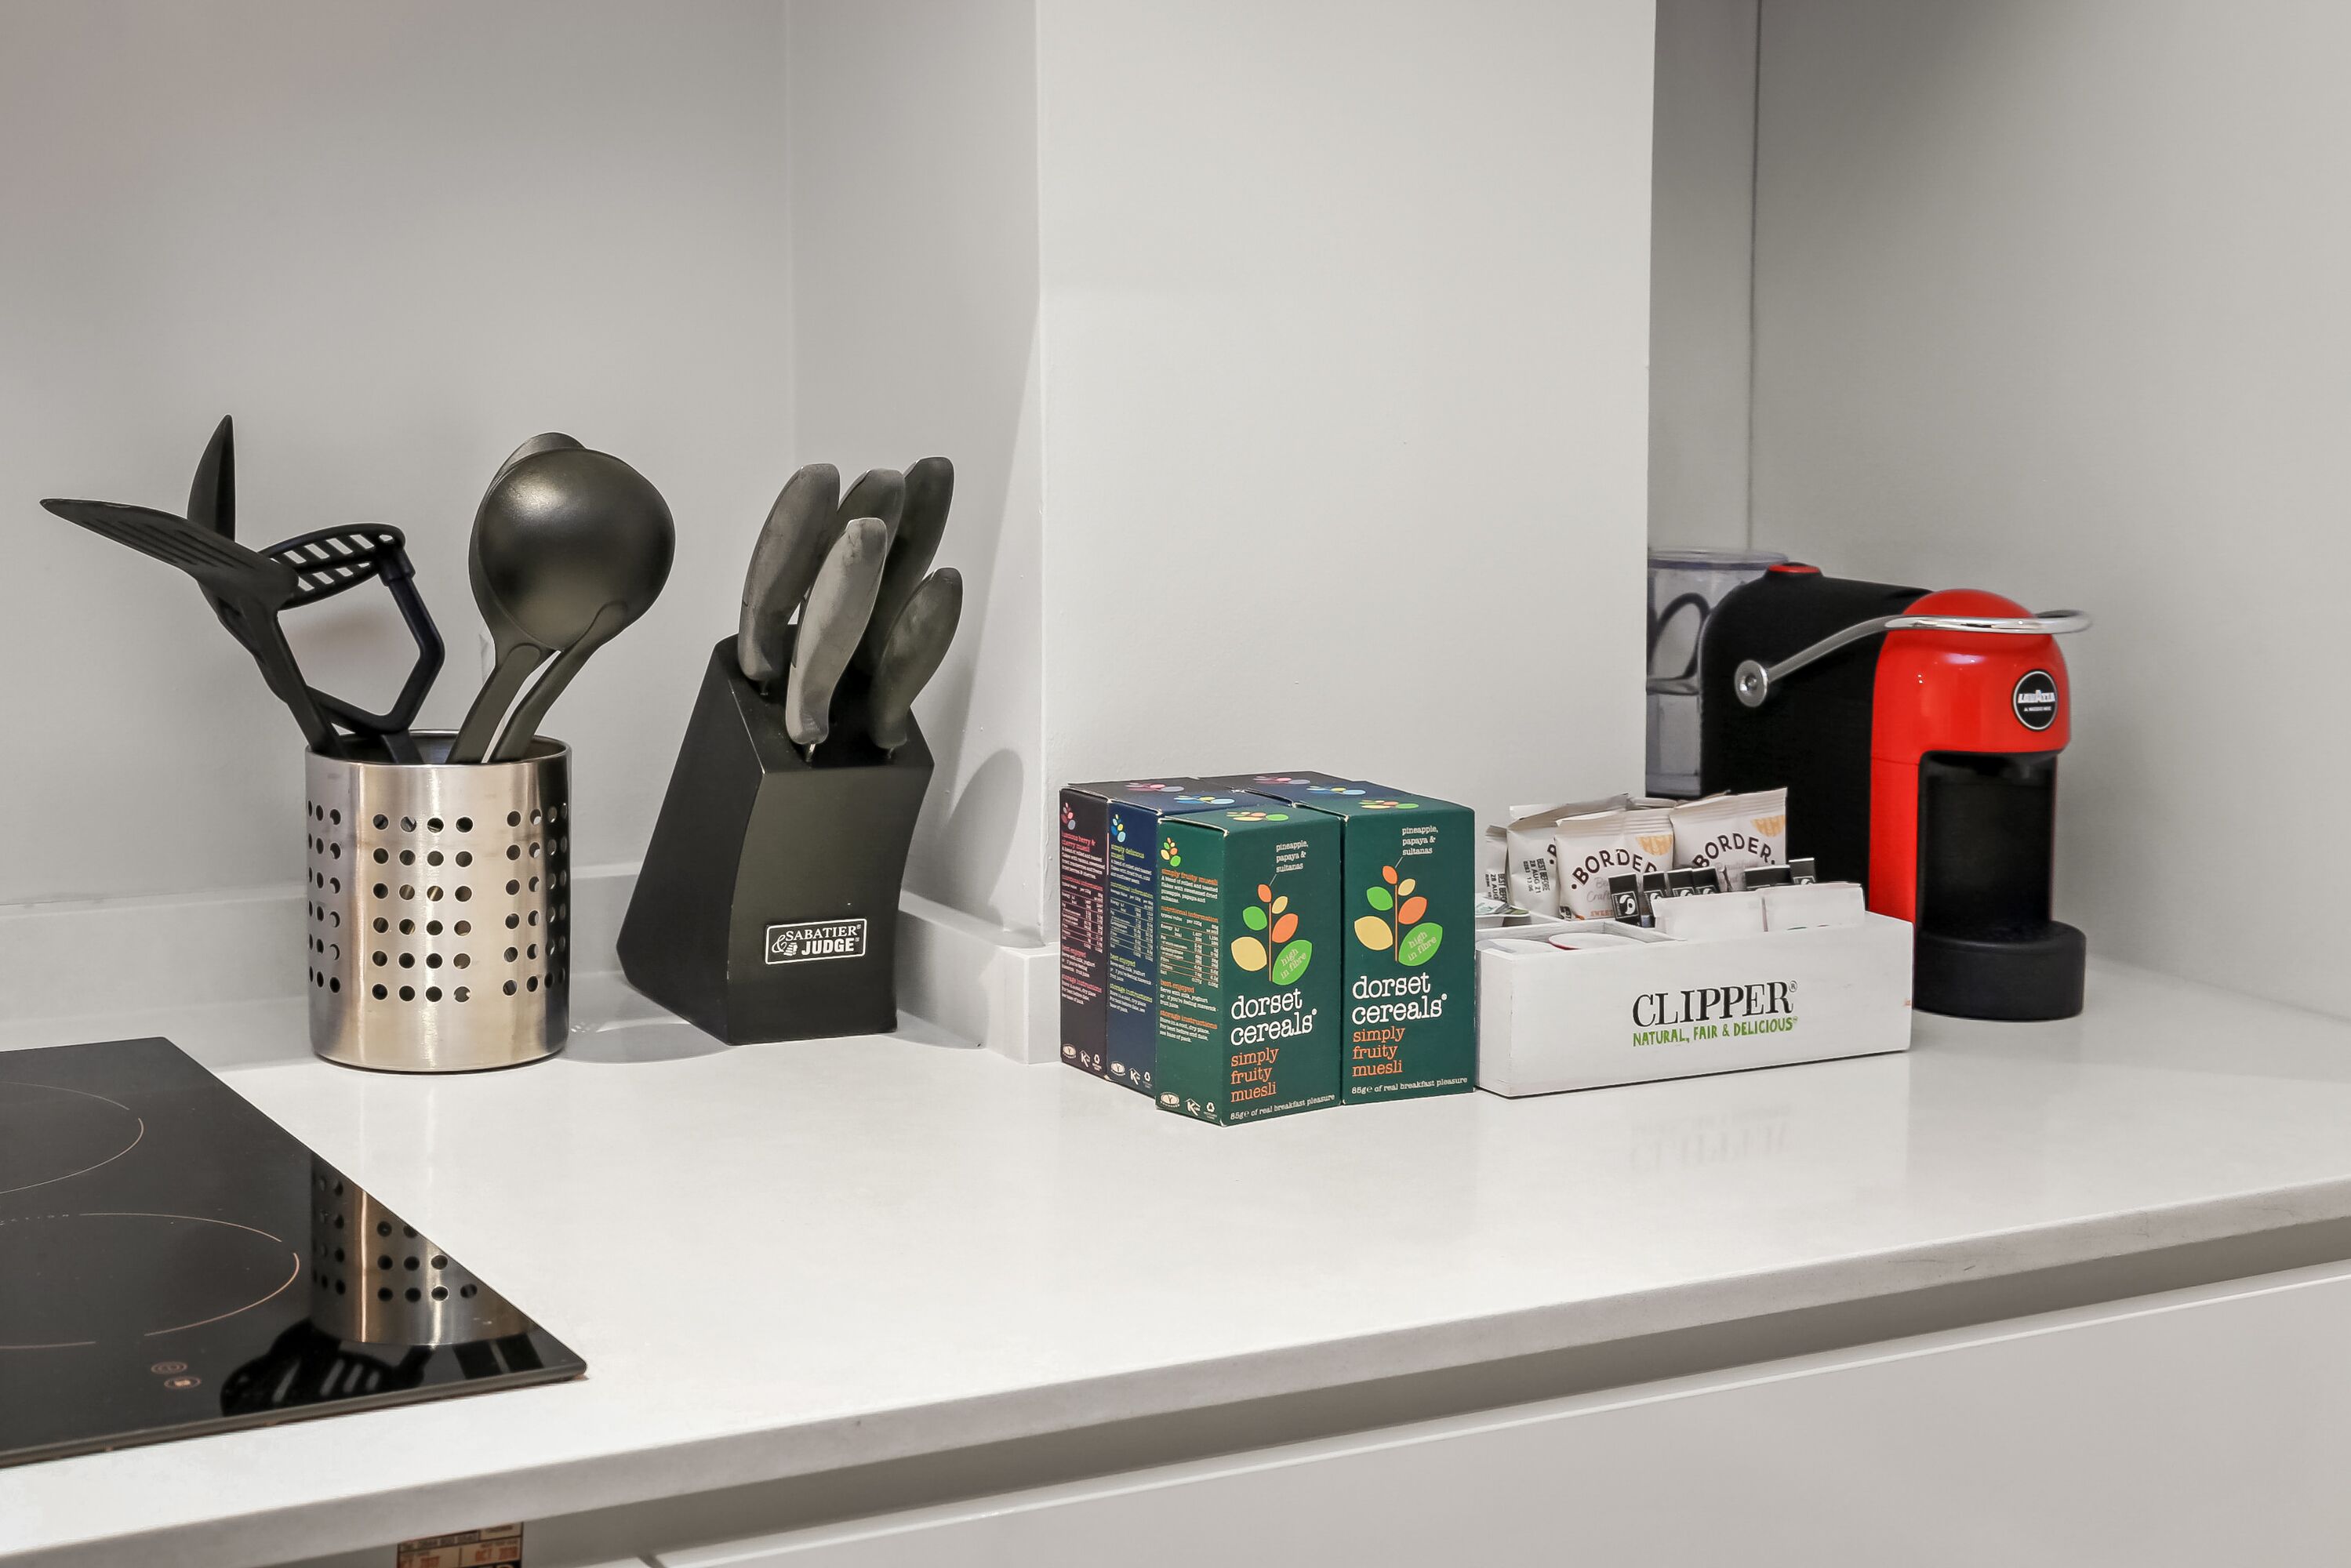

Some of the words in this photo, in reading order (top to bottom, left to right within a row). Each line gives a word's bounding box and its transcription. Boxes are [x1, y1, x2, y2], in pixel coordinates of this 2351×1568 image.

[1401, 825, 1439, 837] pineapple,
[1276, 840, 1309, 852] pineapple,
[1402, 837, 1428, 847] papaya
[1276, 852, 1300, 863] papaya
[1276, 863, 1304, 873] sultanas
[1408, 931, 1427, 949] high
[1408, 952, 1418, 961] in
[1417, 935, 1437, 954] fibre
[1280, 970, 1290, 979] in
[1288, 953, 1307, 972] fibre
[1281, 948, 1299, 967] high
[1352, 972, 1431, 1000] dorset
[1230, 988, 1303, 1020] dorset
[1353, 1025, 1406, 1044] simply
[1633, 1028, 1690, 1047] NATURAL,
[1693, 1023, 1718, 1040] FAIR
[1722, 1023, 1730, 1036] &
[1230, 1047, 1280, 1067] simply
[1352, 1044, 1398, 1060] fruity
[1230, 1067, 1273, 1085] fruity
[1352, 1060, 1403, 1077] muesli
[1230, 1082, 1277, 1103] muesli
[1400, 1080, 1435, 1091] breakfast
[1436, 1076, 1468, 1087] pleasure
[1251, 1108, 1259, 1116] of
[1259, 1106, 1272, 1115] real
[1274, 1100, 1306, 1112] breakfast
[1306, 1094, 1335, 1106] pleasure
